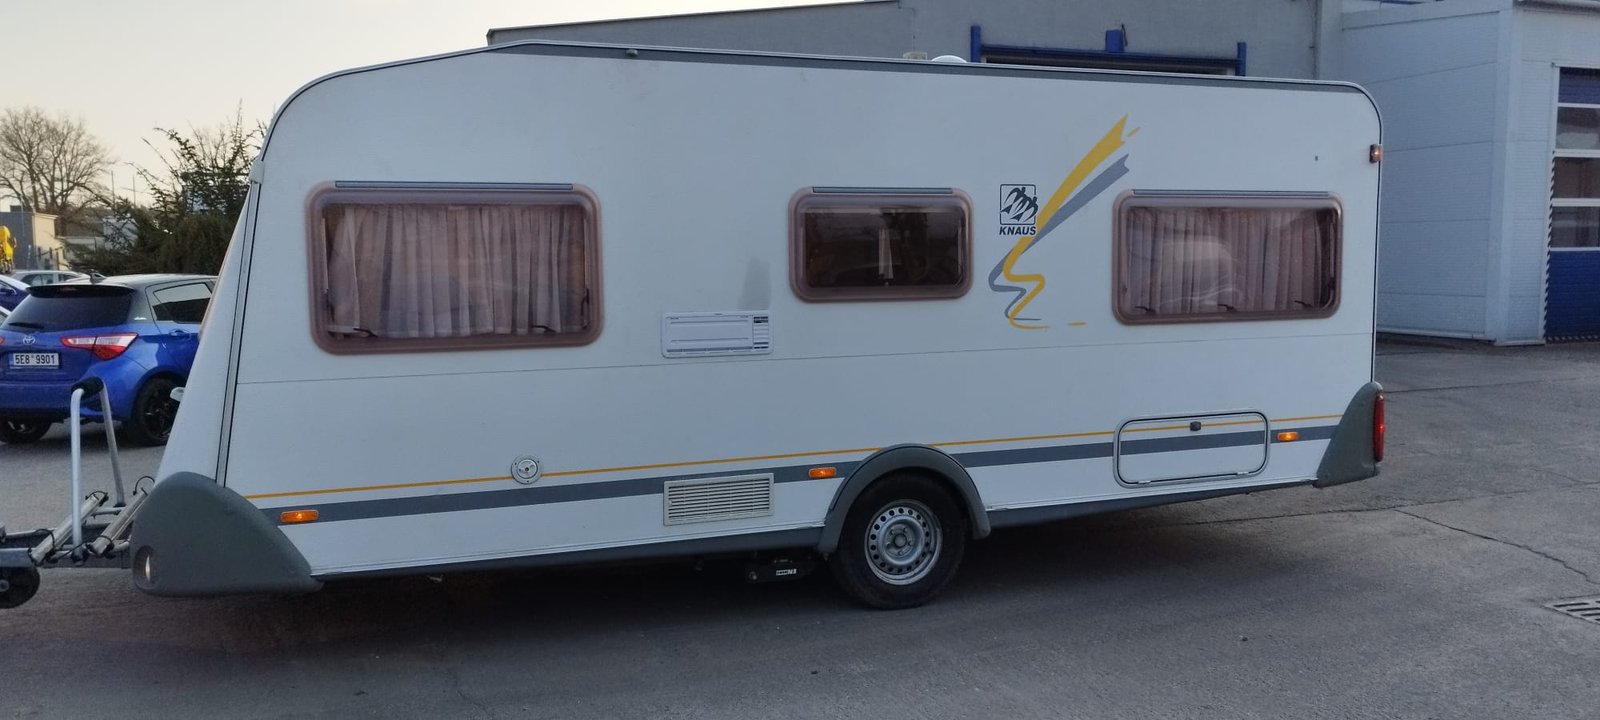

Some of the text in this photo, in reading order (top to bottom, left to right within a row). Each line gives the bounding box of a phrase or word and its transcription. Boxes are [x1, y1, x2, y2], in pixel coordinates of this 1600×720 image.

[999, 226, 1037, 236] KNAUS
[15, 354, 55, 365] 5E8 9901
